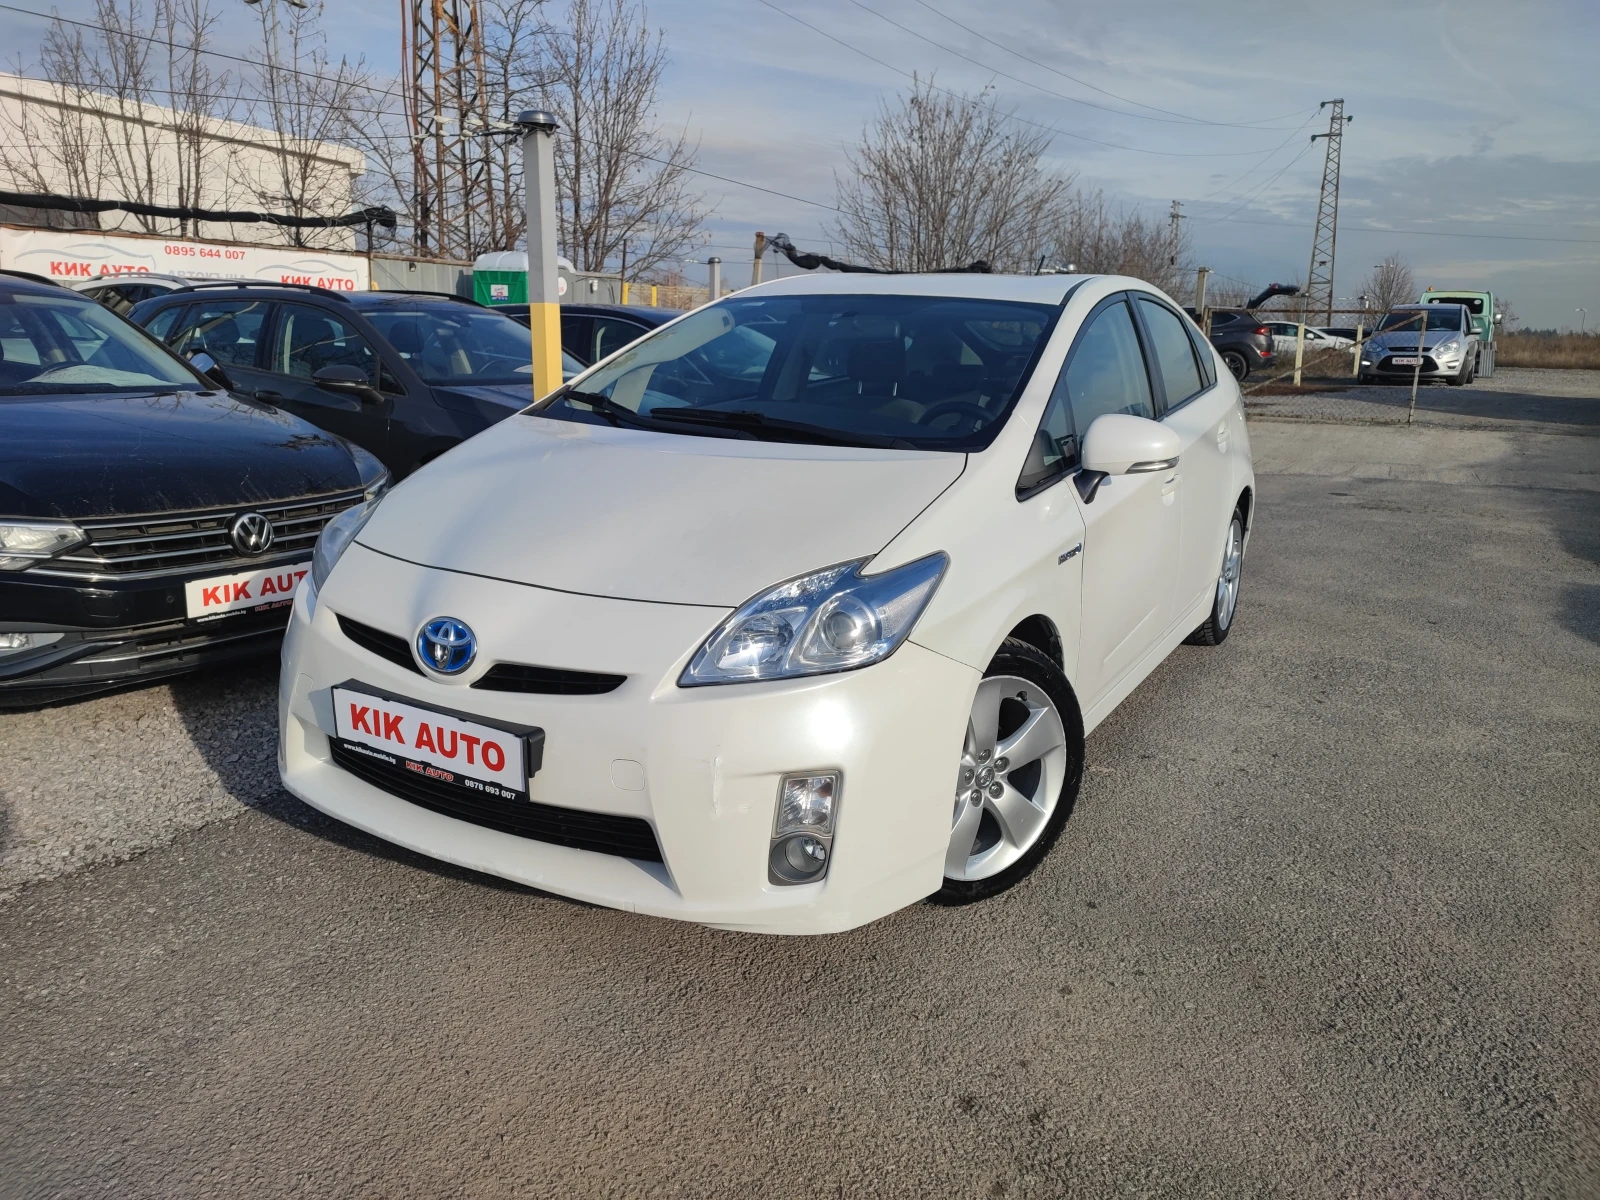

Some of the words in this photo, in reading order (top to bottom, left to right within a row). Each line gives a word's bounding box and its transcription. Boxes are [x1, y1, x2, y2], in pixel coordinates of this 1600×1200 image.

[164, 245, 195, 257] 0895
[199, 248, 221, 258] 644
[225, 250, 246, 260] 007
[50, 261, 91, 276] КИК
[99, 264, 149, 278] АУТО
[281, 275, 311, 286] КИК
[317, 277, 354, 291] АУТО
[202, 580, 251, 607] KIK
[260, 570, 309, 596] AUT
[350, 703, 406, 745] KIK
[415, 722, 506, 772] AUTO
[405, 760, 423, 773] KIK
[425, 767, 454, 782] AUTO
[464, 779, 484, 790] 0878
[485, 785, 500, 795] 693
[501, 790, 516, 800] 007
